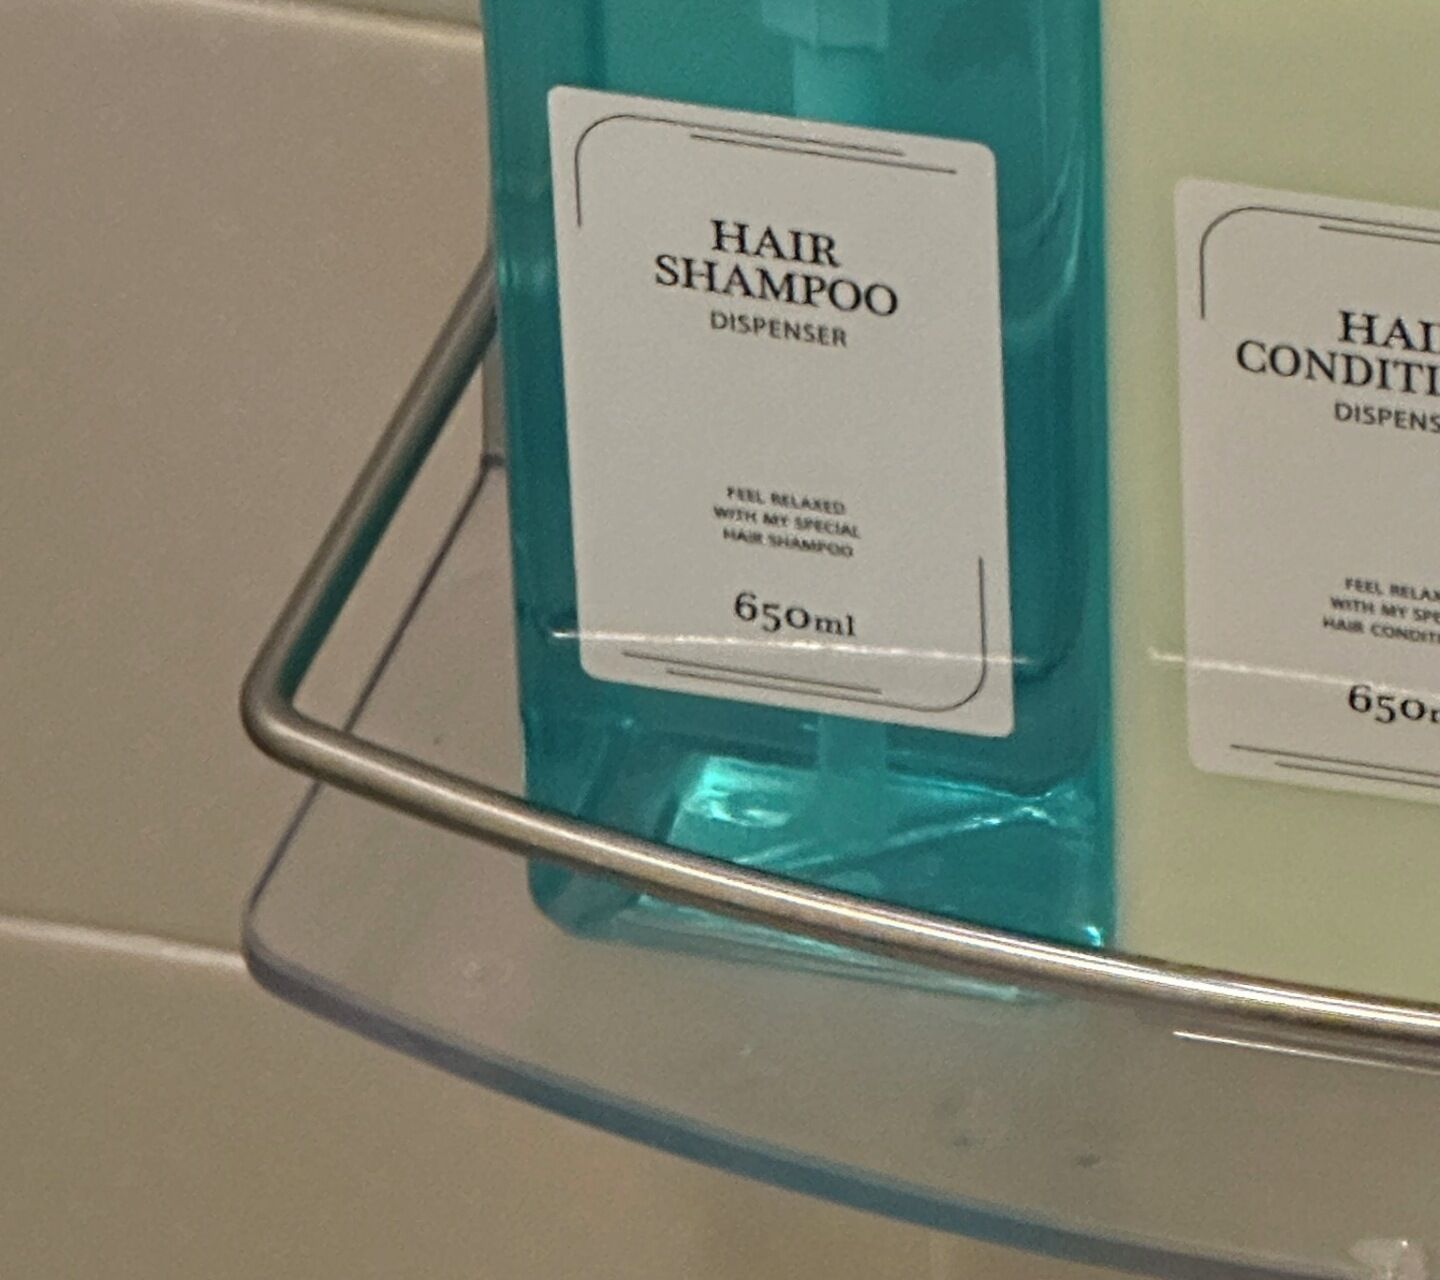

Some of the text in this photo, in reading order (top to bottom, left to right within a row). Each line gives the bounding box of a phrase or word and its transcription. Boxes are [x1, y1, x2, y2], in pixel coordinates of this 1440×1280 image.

[711, 219, 840, 268] HAIR
[655, 254, 898, 317] SHAMPOO
[710, 310, 847, 347] DISPENSER
[726, 486, 846, 516] FEEL RELAXED
[713, 506, 859, 538] WITH MY SPECIAL
[722, 528, 854, 557] HAIR SHAMPOO
[1344, 577, 1384, 596] FEEL
[734, 591, 856, 637] 650ml
[1330, 596, 1375, 615] WITH
[1380, 603, 1407, 619] MY
[1322, 616, 1364, 633] HAIR
